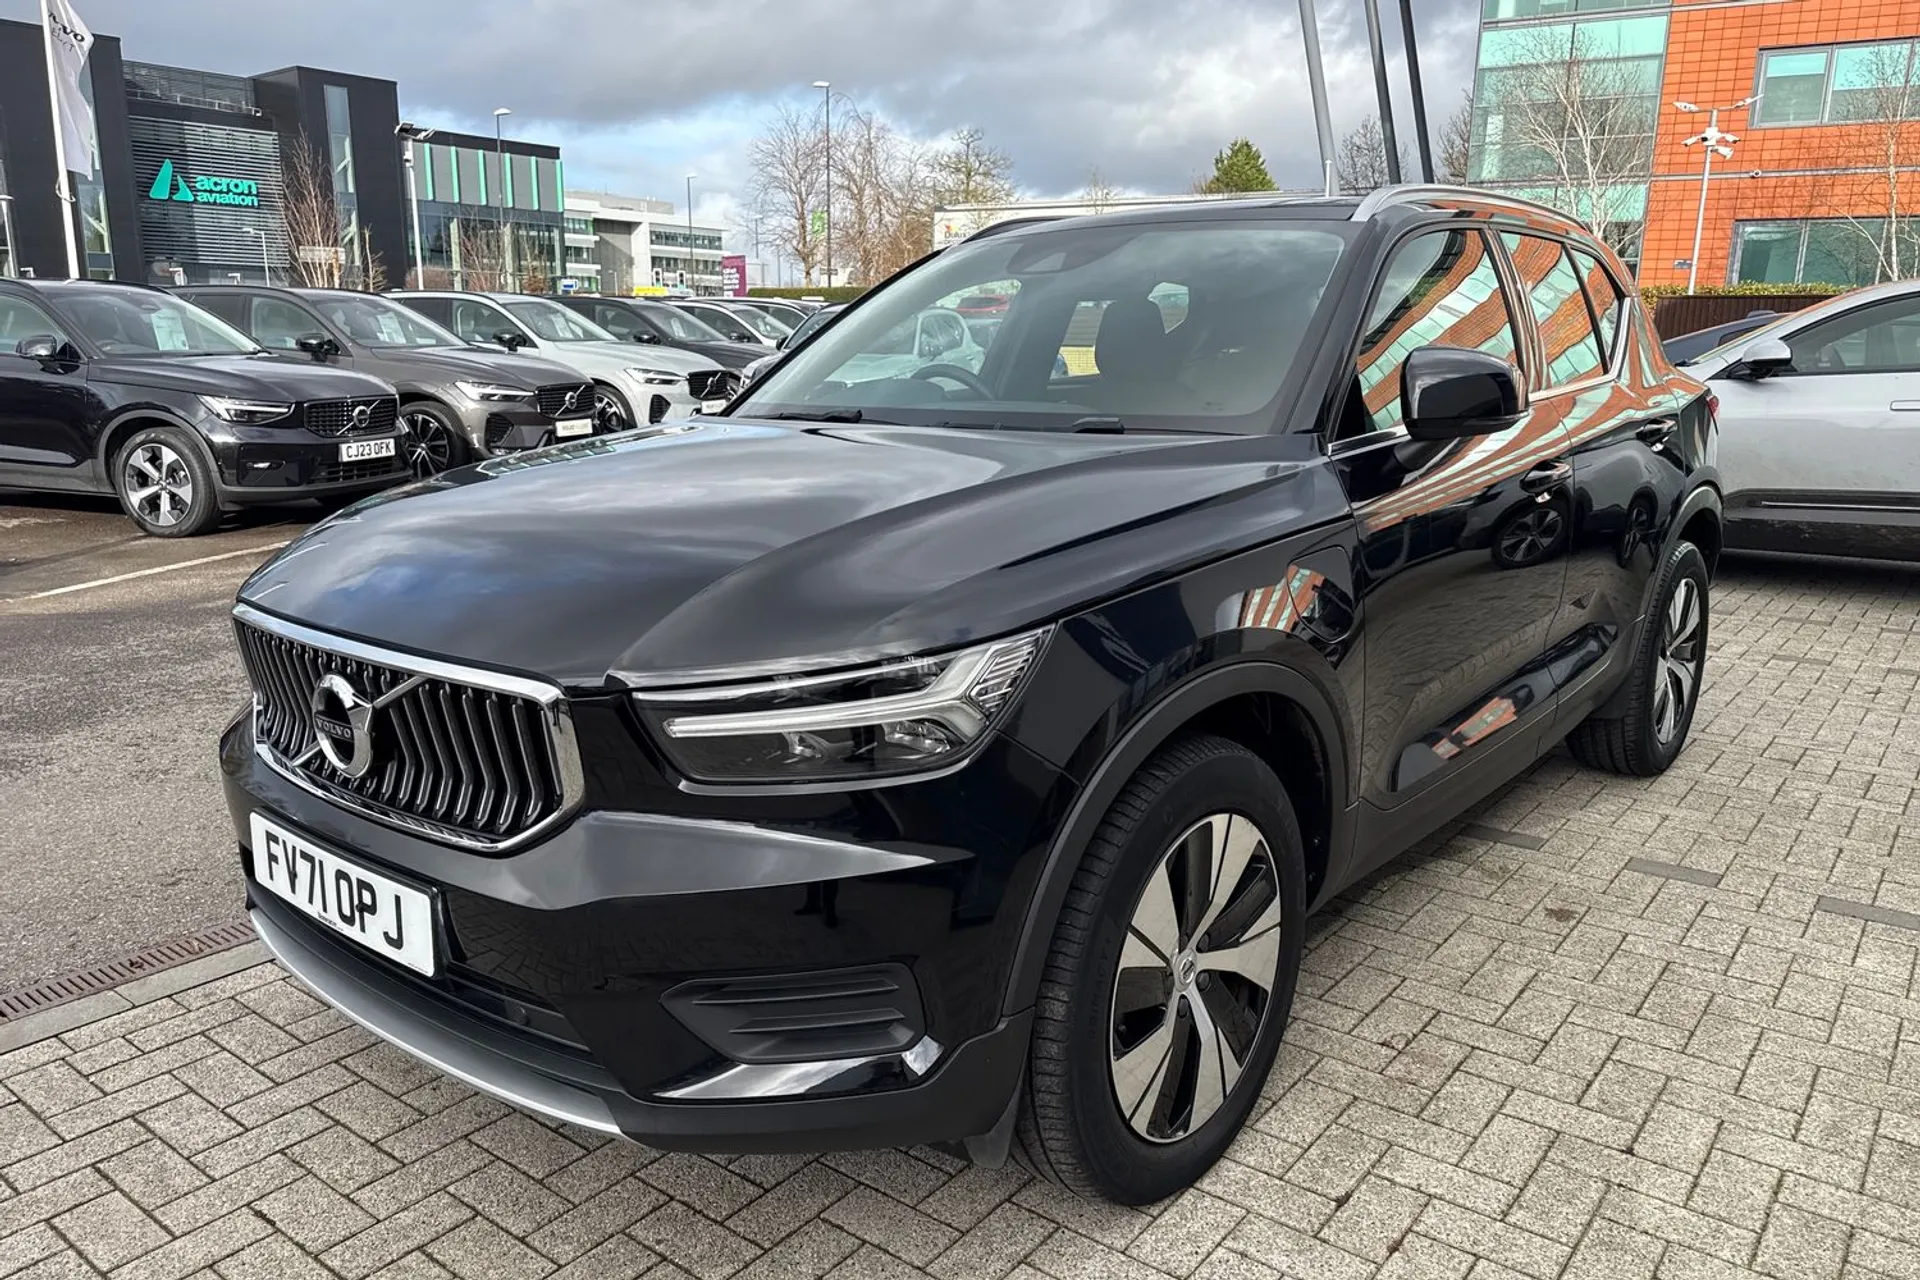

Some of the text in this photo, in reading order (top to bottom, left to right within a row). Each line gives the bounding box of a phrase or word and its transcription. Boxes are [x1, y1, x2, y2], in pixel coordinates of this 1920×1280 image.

[195, 175, 258, 195] acron
[196, 192, 259, 207] aviation
[346, 441, 392, 458] CJ23 OFK
[315, 718, 351, 738] VOLVO
[265, 829, 404, 951] FV71 OPJ
